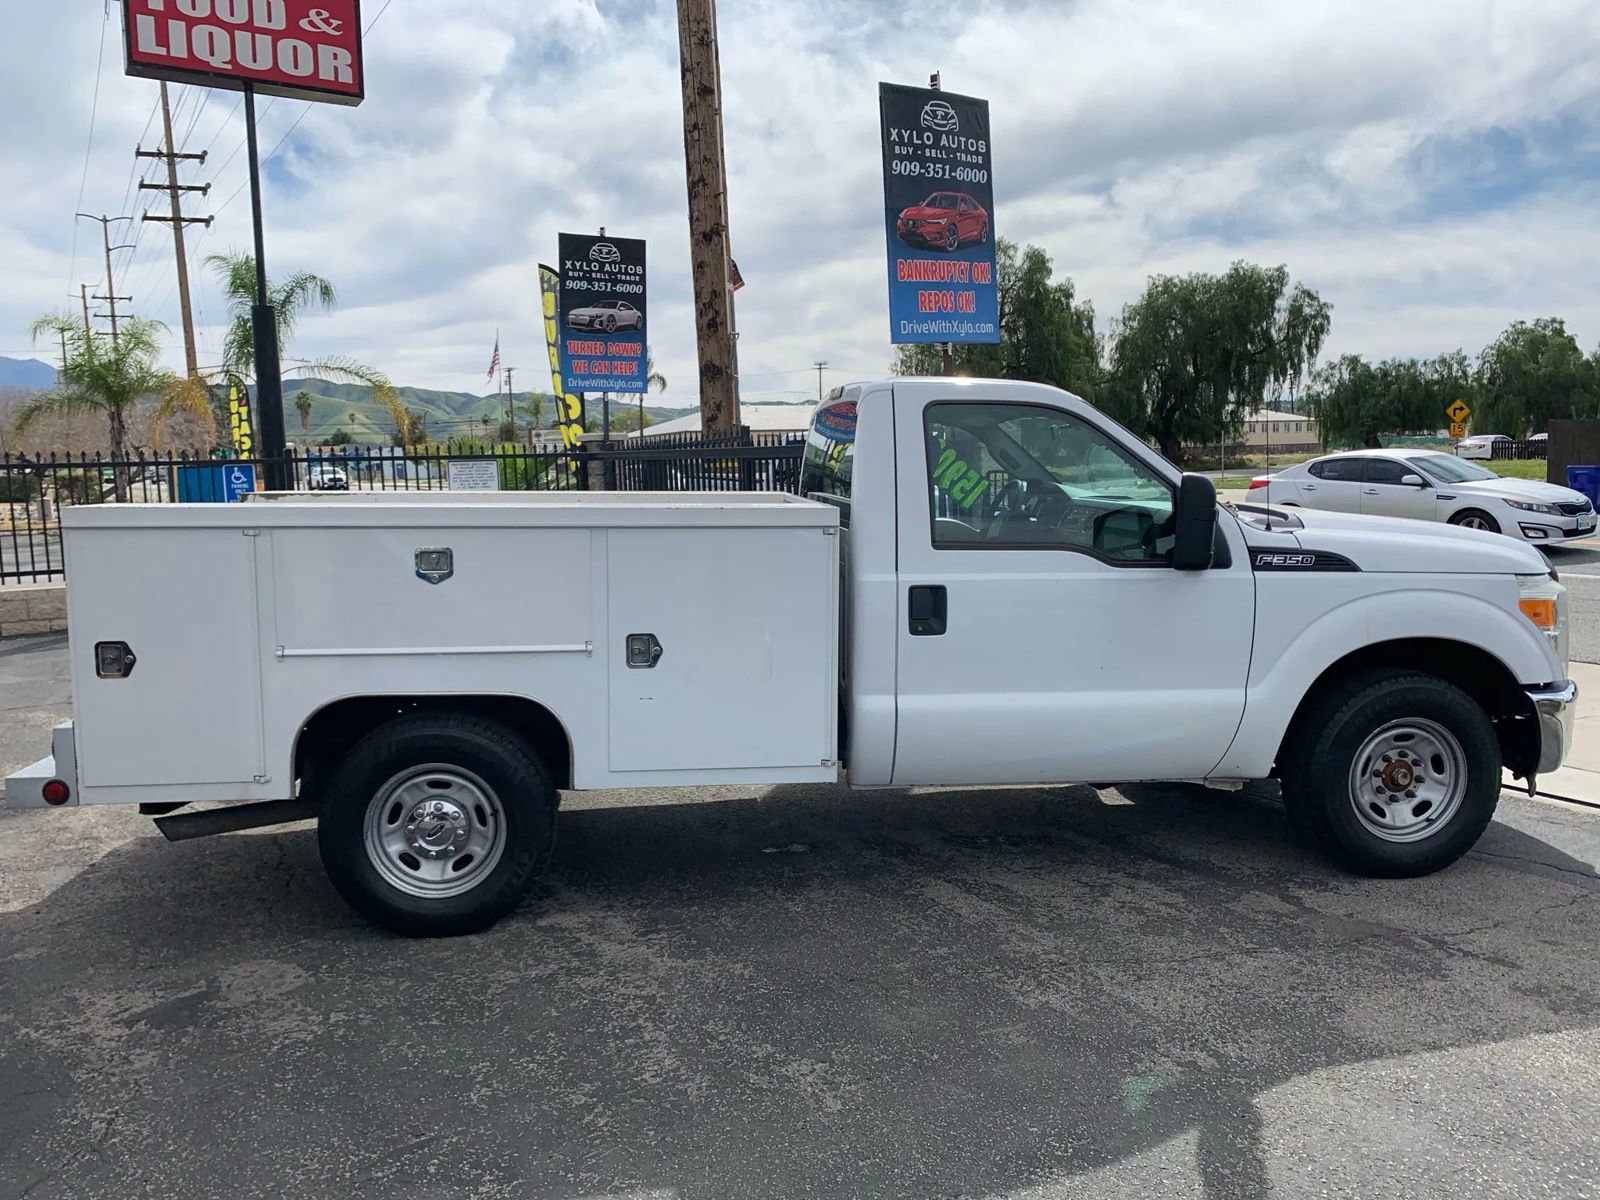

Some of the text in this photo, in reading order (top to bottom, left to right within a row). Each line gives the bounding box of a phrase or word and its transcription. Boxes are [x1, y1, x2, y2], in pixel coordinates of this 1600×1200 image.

[147, 0, 343, 36] OD &
[136, 13, 353, 84] LIQUOR
[890, 127, 987, 152] XYLO AUTOS
[895, 145, 914, 155] BUY
[925, 148, 947, 158] SELL
[956, 152, 983, 164] TRADE
[891, 159, 988, 184] 909-351-6000
[565, 260, 643, 274] XYLO AUTOS
[897, 259, 992, 284] BANKRUPTCY OK!
[565, 280, 643, 294] 909-351-6000
[918, 290, 976, 313] REPOS OK!
[901, 320, 994, 336] DriveWithXylo.com
[566, 340, 643, 357] TURNED DOWN?
[572, 360, 639, 376] WE CAN HELP!
[568, 378, 643, 390] DriveWithXylo.com
[1453, 424, 1464, 433] 15
